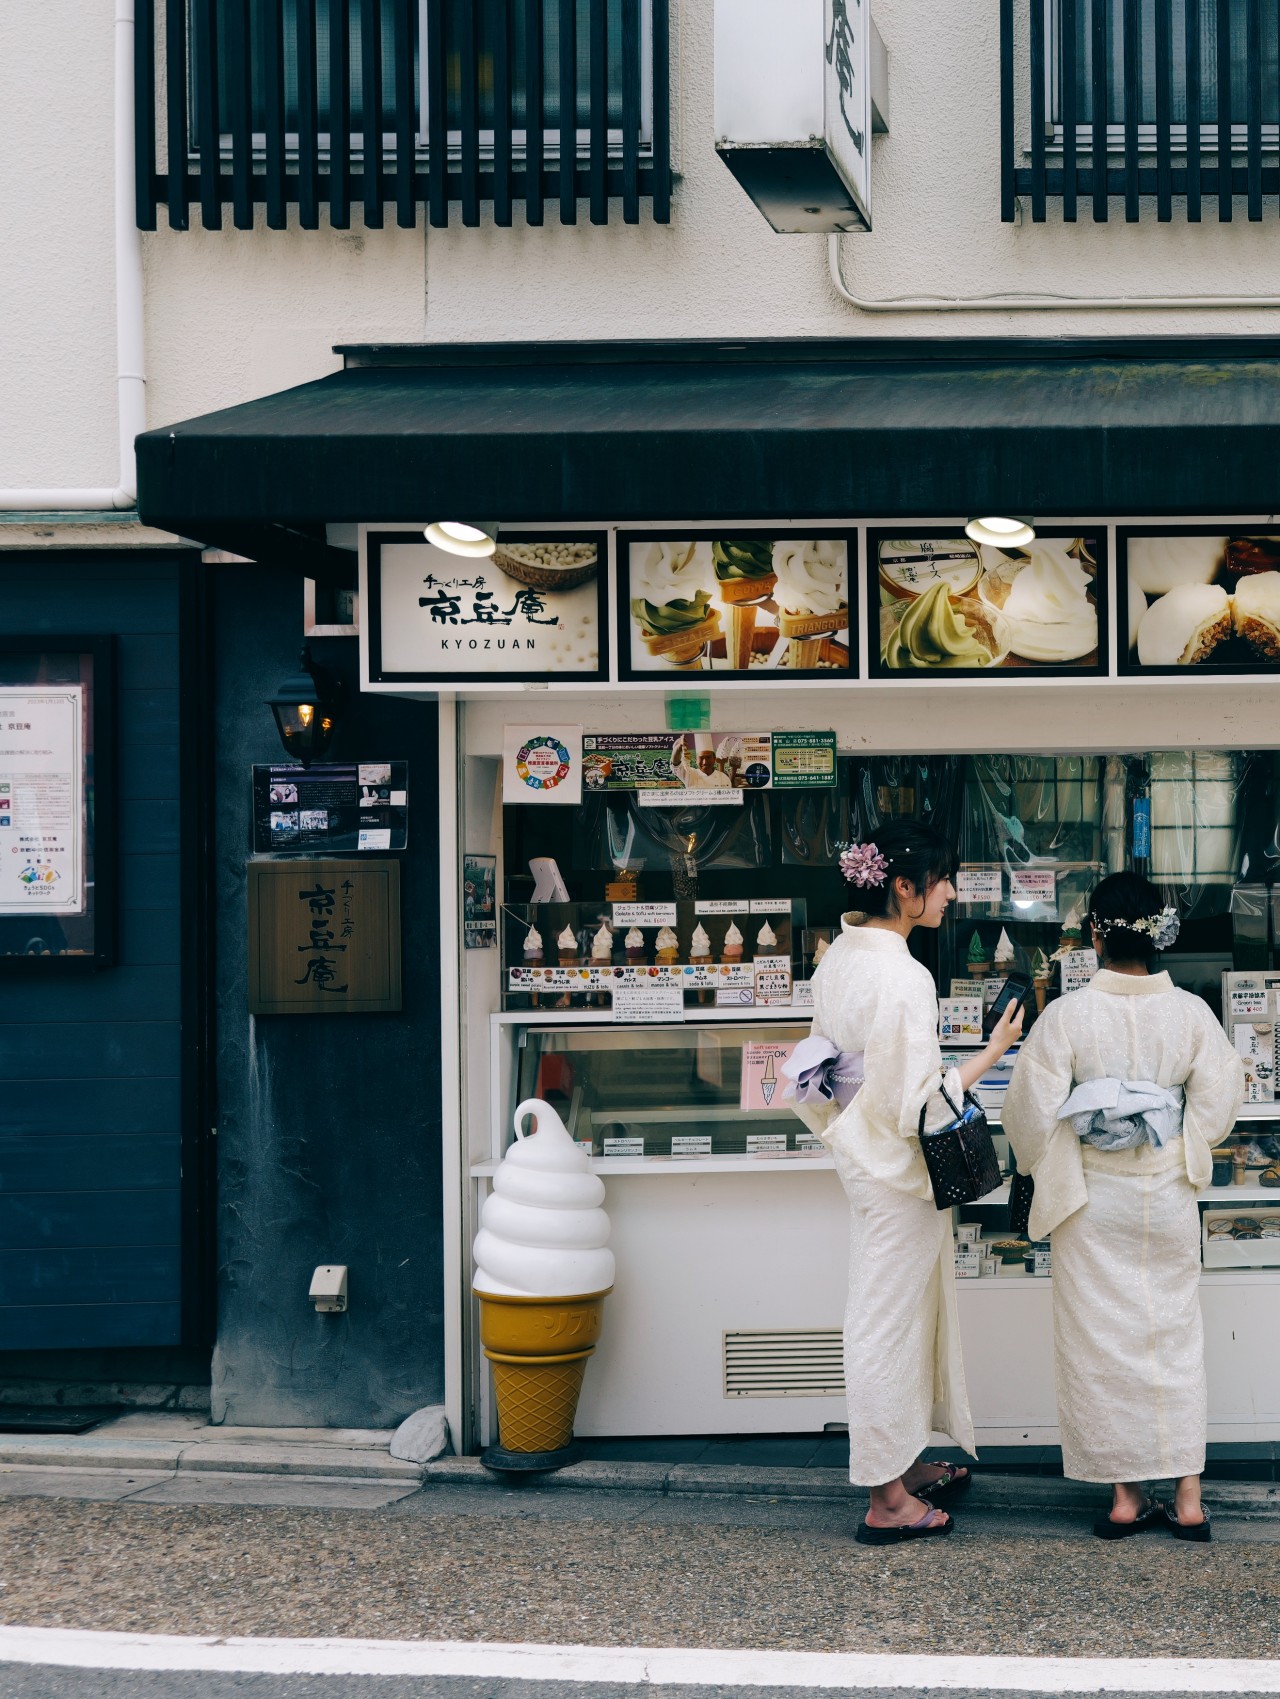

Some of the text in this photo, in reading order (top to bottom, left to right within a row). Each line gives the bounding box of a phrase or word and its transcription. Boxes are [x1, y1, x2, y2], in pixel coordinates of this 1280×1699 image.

[423, 573, 487, 590] 手づくり工房
[418, 587, 559, 626] 京豆庵
[441, 639, 536, 649] KYOZUAN
[340, 880, 355, 939] 手づくり工房
[294, 883, 349, 993] 京豆庵
[774, 1050, 787, 1058] OK
